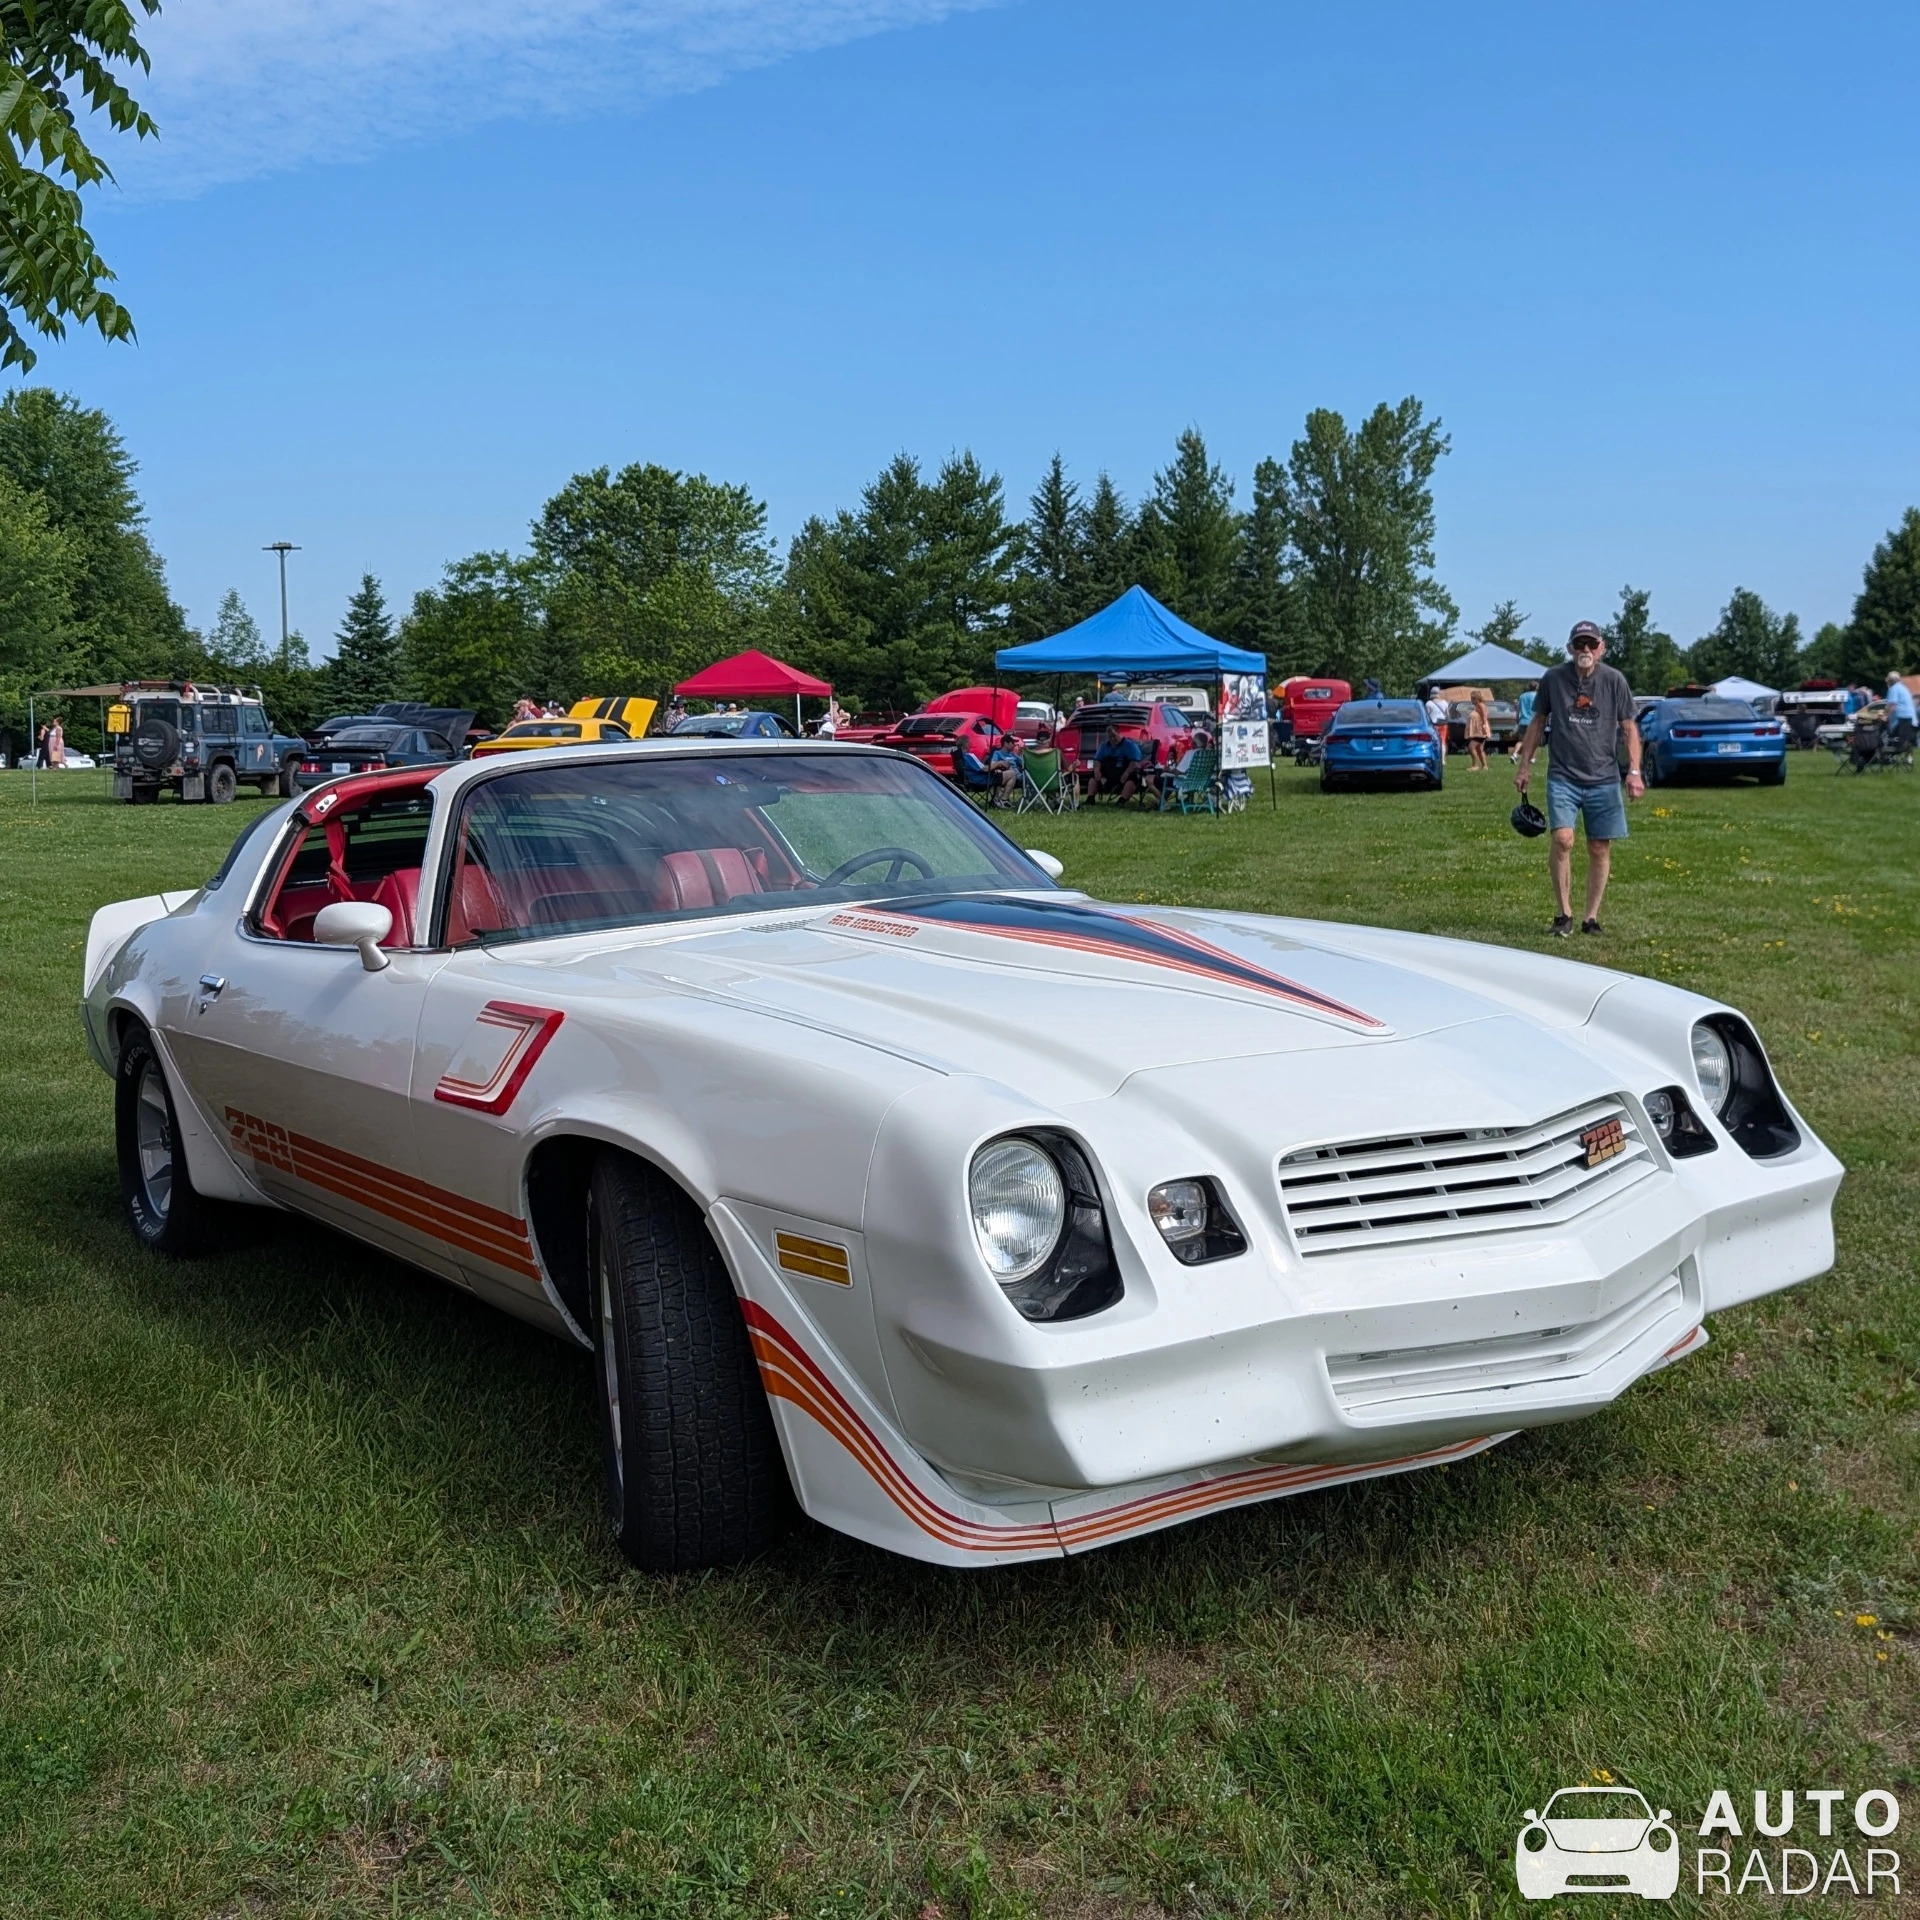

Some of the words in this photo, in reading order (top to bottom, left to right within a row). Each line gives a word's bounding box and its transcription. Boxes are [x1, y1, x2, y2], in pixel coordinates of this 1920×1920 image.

[828, 914, 855, 927] AIR
[849, 918, 920, 938] INDUCTION
[1582, 1119, 1627, 1167] Z28
